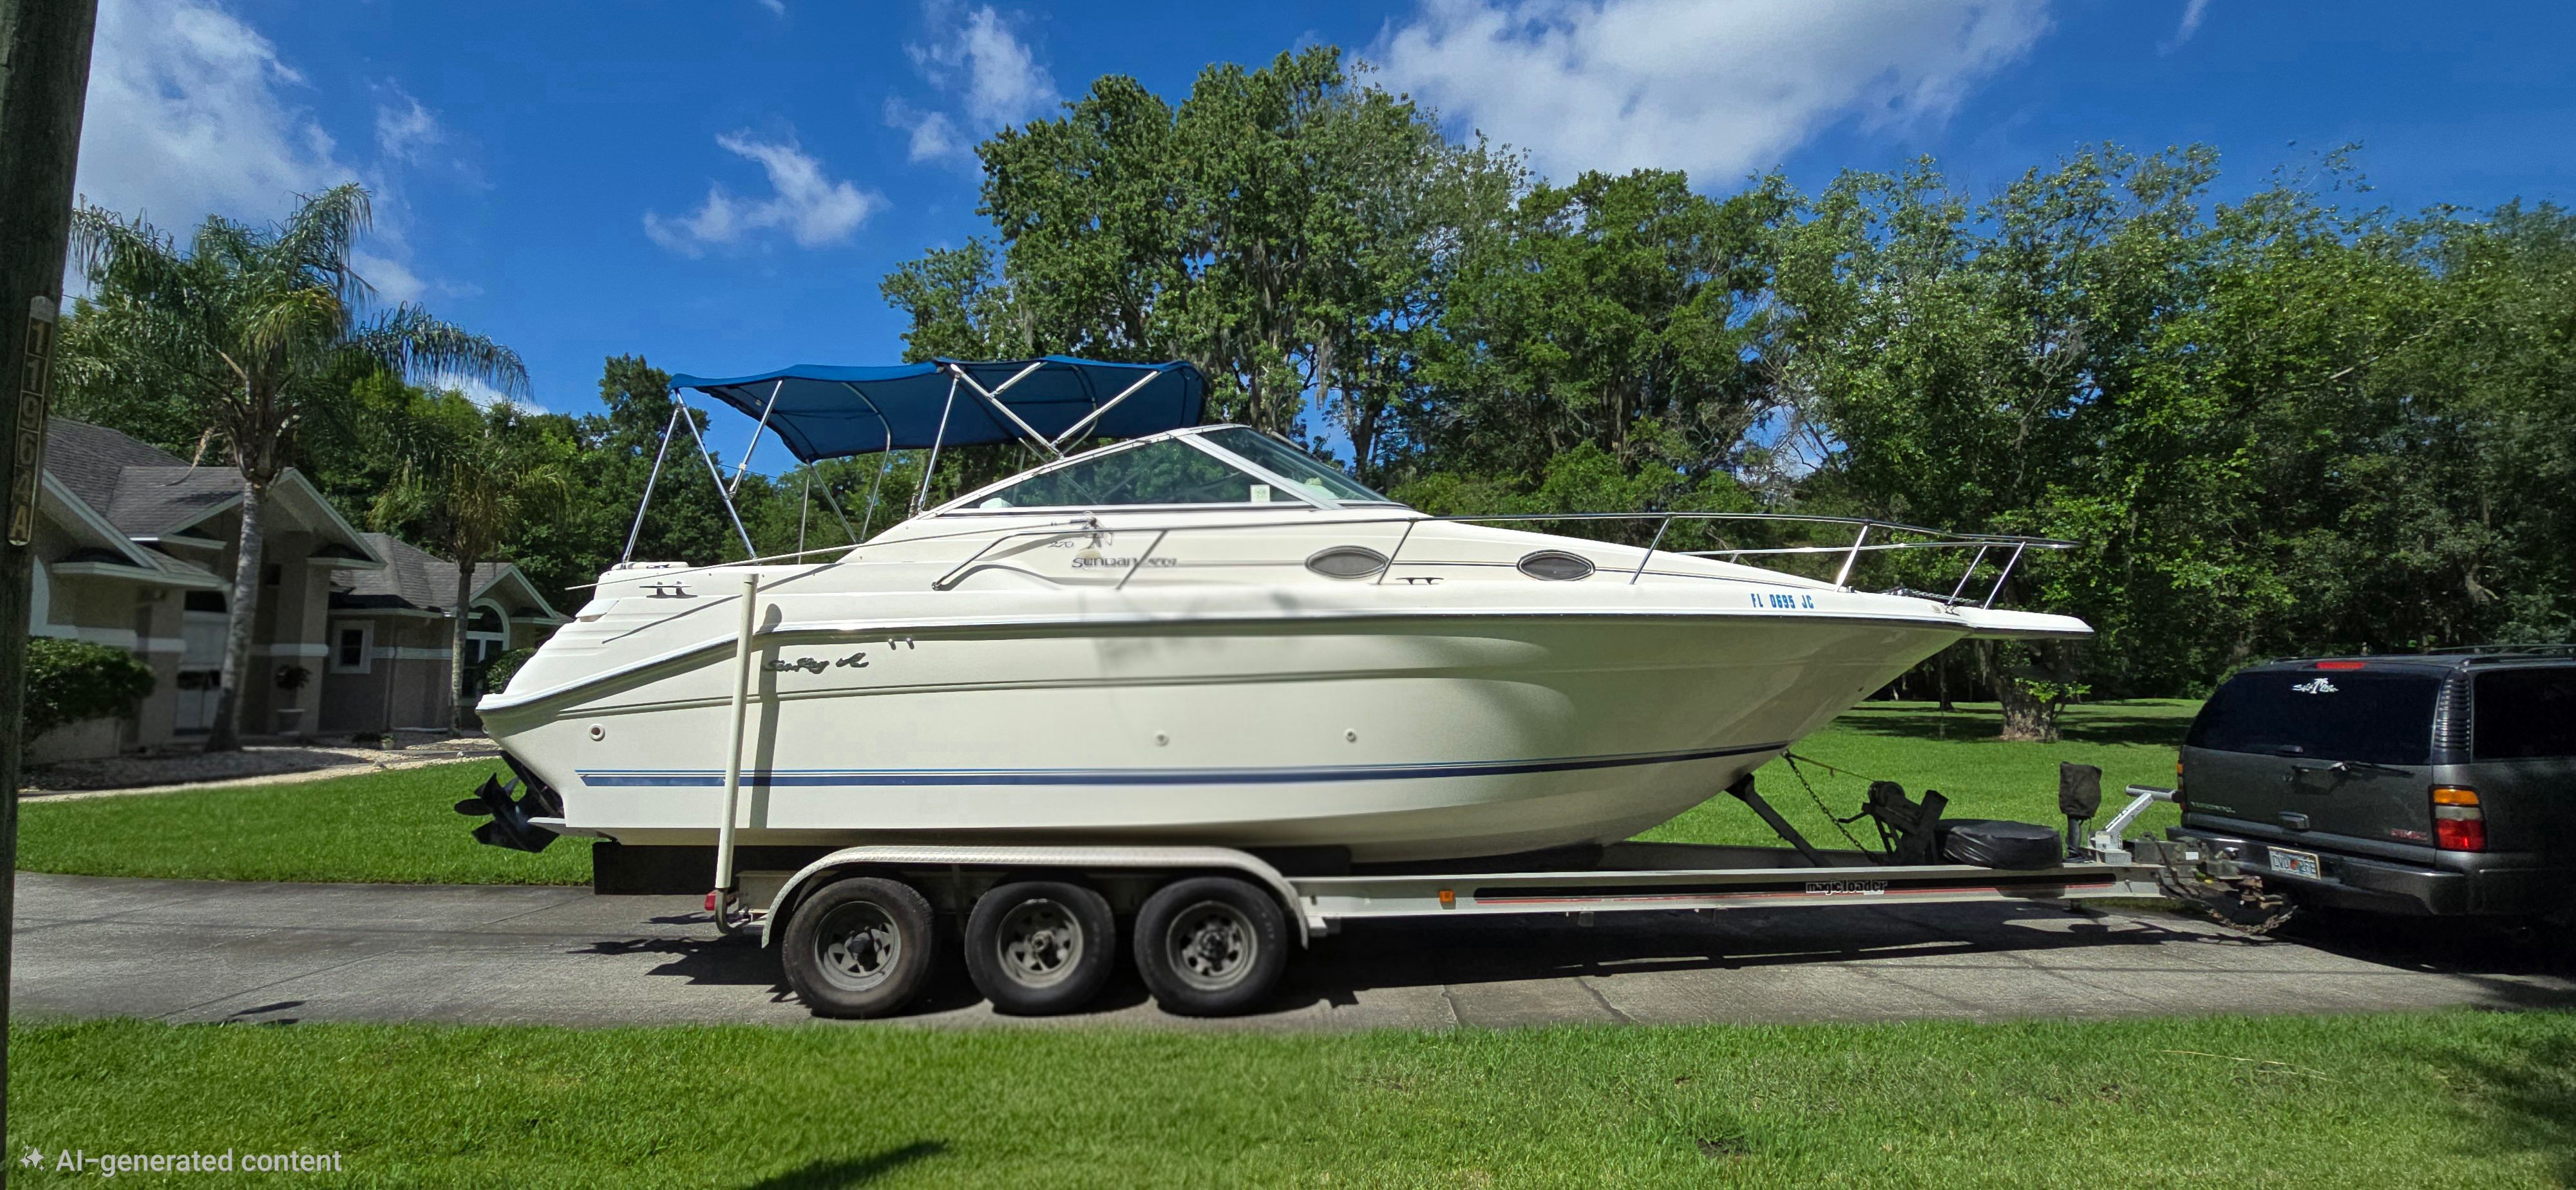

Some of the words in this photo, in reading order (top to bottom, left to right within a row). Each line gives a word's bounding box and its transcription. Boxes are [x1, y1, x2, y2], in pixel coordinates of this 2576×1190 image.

[1750, 593, 1763, 608] FL
[1769, 594, 1795, 609] 0695
[1801, 594, 1814, 609] JC
